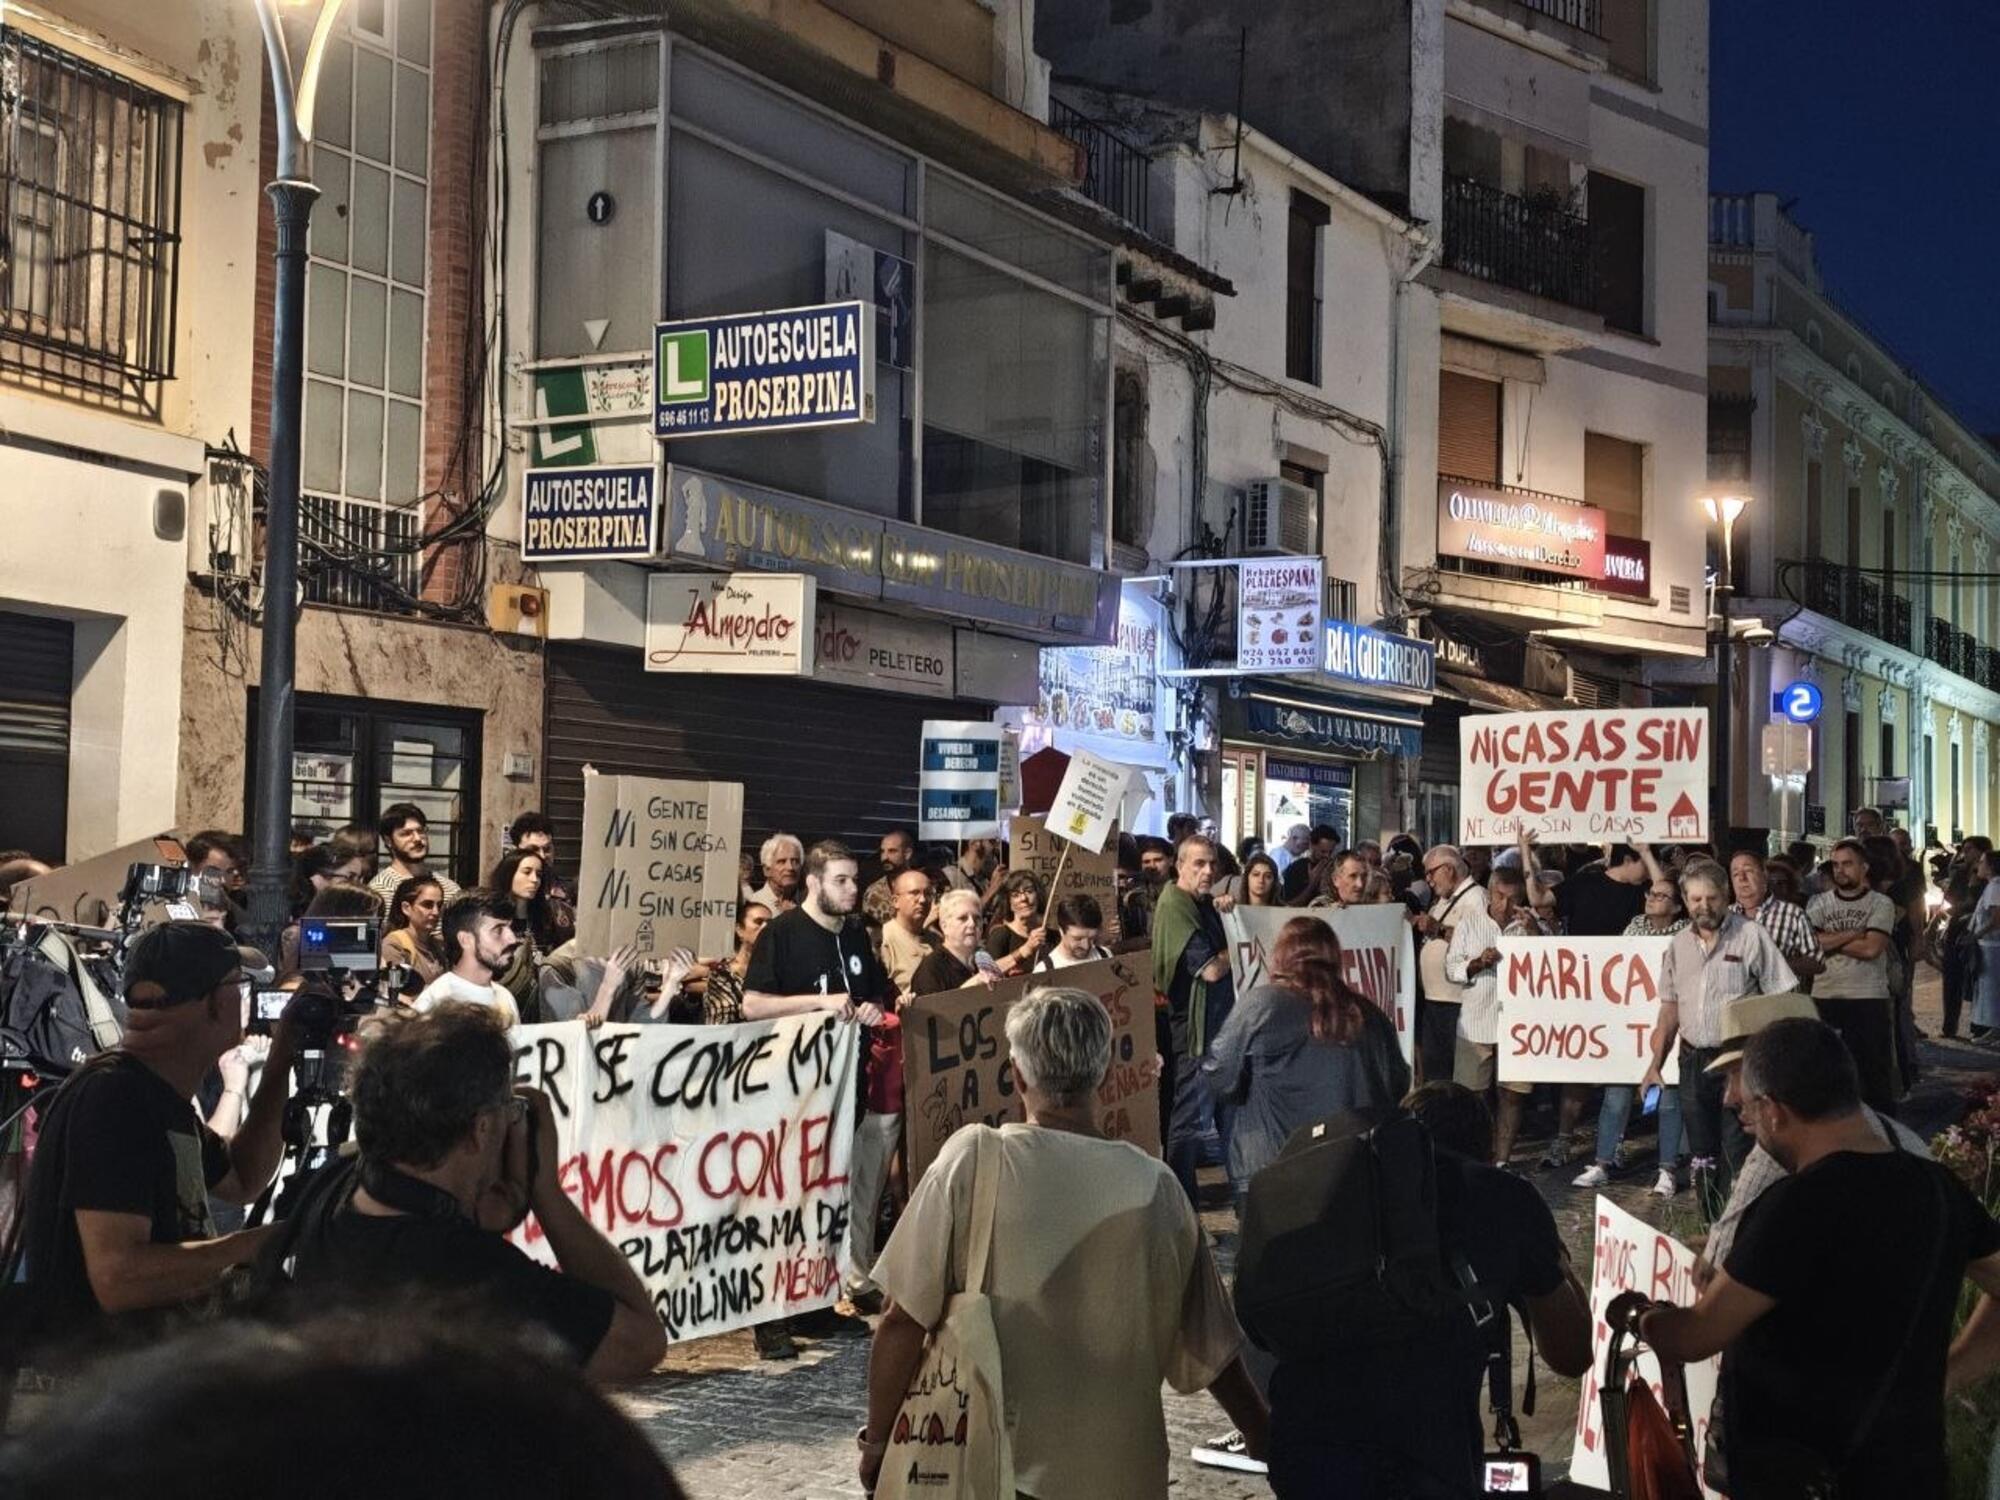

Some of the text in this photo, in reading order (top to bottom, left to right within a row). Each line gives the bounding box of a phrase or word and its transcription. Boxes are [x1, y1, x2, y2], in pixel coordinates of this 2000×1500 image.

[715, 313, 857, 370] AUTOESCUELA
[667, 341, 703, 395] L
[713, 370, 856, 423] PROSERPINA
[529, 476, 648, 513] AUTOESCUELA
[527, 514, 648, 550] PROSERPINA
[714, 490, 935, 587] AUTOESCUELA
[1246, 565, 1316, 589] PLAZA ESPAÑA
[684, 600, 796, 649] Almendro
[869, 647, 944, 676] PELETERO
[1357, 634, 1430, 689] GUERRERO
[938, 742, 973, 755] VIVIENDA
[1317, 715, 1402, 746] LAVANDERIA
[944, 756, 979, 770] DERECHO
[647, 796, 708, 820] GENTE
[1486, 768, 1663, 815] GENTE
[683, 831, 728, 853] CASA
[1020, 831, 1038, 851] SI
[1465, 819, 1484, 842] NI
[1541, 816, 1572, 834] SIN
[1589, 815, 1645, 835] CASAS
[648, 861, 703, 883] CASAS
[680, 897, 736, 919] GENTE
[927, 1007, 997, 1074] LOS
[1511, 1023, 1609, 1060] SOMOS
[593, 1033, 641, 1104] SE
[651, 1033, 780, 1110] COME
[698, 1118, 788, 1200] CON
[799, 1116, 850, 1193] EL
[816, 1199, 850, 1244] DE
